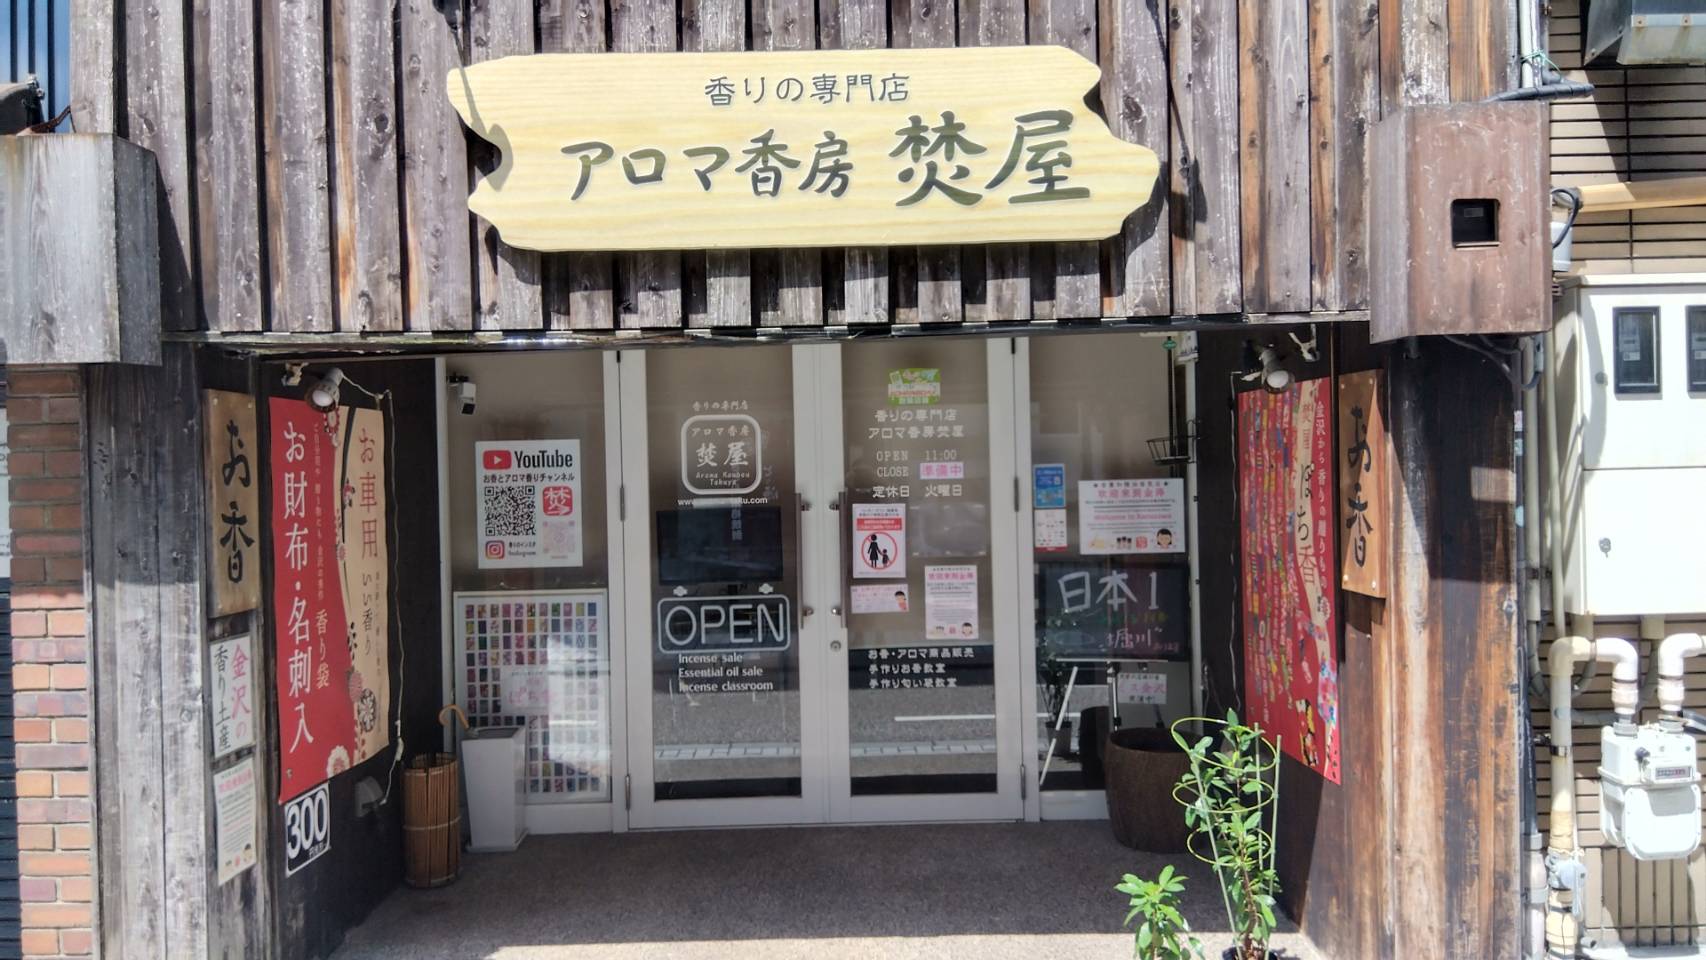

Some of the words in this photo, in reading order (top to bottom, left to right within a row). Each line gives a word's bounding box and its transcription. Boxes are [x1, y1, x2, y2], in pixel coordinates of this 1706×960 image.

[704, 73, 911, 107] 香りの専門店
[561, 128, 855, 201] アロマ香房
[888, 109, 1090, 207] 焚屋
[692, 400, 748, 411] 香りの専門店
[874, 409, 957, 422] 香りの専門店
[691, 425, 750, 436] アロマ香房
[868, 425, 964, 439] アロマ香房焚屋
[514, 449, 573, 469] YouTube
[695, 441, 749, 467] 焚屋
[876, 451, 909, 462] OPEN
[925, 449, 957, 461] 11:00
[483, 472, 575, 483] お香とアロマ香りチャンネル
[877, 466, 909, 478] CLOSE
[922, 464, 962, 476] 準備中
[359, 428, 378, 560] お車用
[872, 485, 910, 498] 定休日
[925, 484, 962, 497] 火曜日
[1346, 405, 1373, 568] お香
[220, 419, 255, 584] お香
[283, 421, 314, 754] お財布・名刺入
[665, 603, 785, 646] OPEN
[315, 608, 330, 689] 香り袋
[868, 647, 974, 659] お香・アロマ商品販売
[678, 654, 717, 664] Incense
[721, 653, 743, 663] sale
[678, 667, 723, 678] Essential
[726, 666, 739, 676] oil
[742, 666, 763, 676] sale
[232, 644, 250, 739] 金沢の
[679, 682, 718, 692] Incense
[721, 681, 773, 691] classroom
[287, 790, 328, 859] 300
